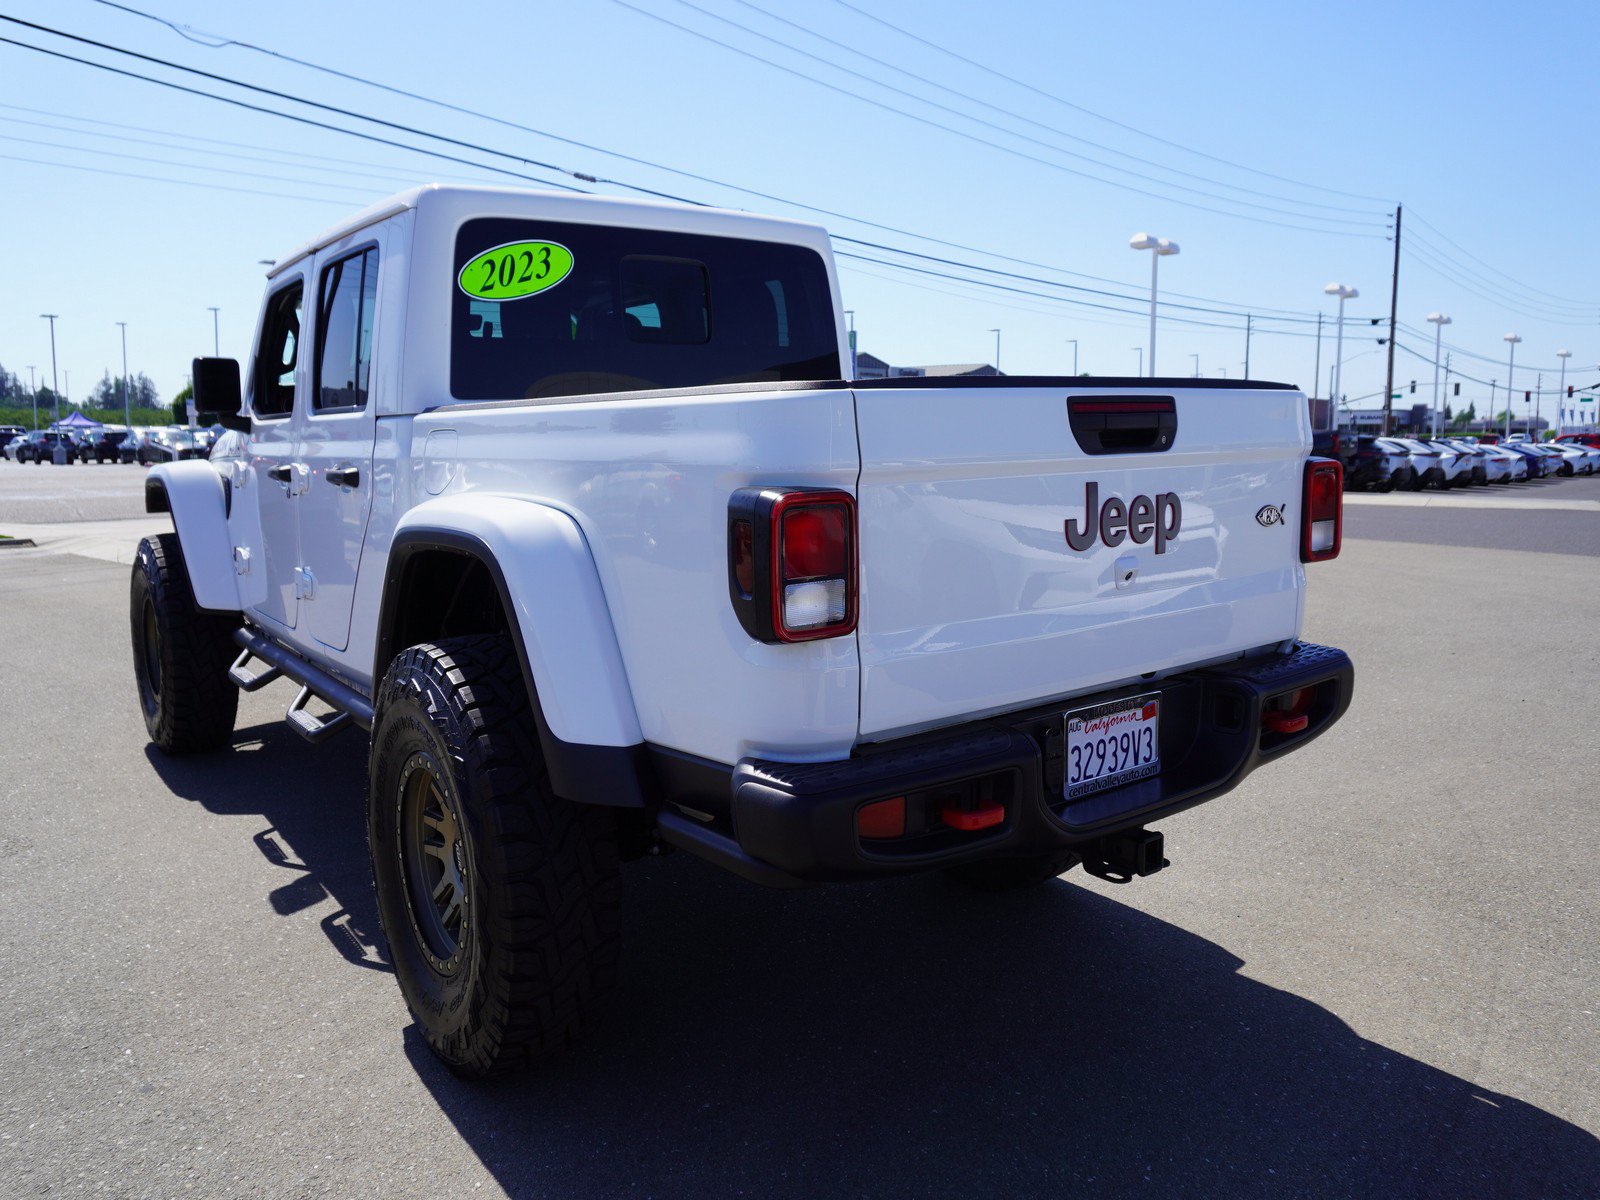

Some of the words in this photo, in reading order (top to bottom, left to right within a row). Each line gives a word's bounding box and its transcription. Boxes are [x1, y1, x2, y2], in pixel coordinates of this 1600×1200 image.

[479, 246, 551, 293] 2023
[1064, 481, 1182, 555] Jeep
[1068, 720, 1082, 733] AUG
[1084, 711, 1142, 735] California
[1070, 726, 1153, 784] 32939V3
[1068, 765, 1158, 798] centralvalleyauto.com
